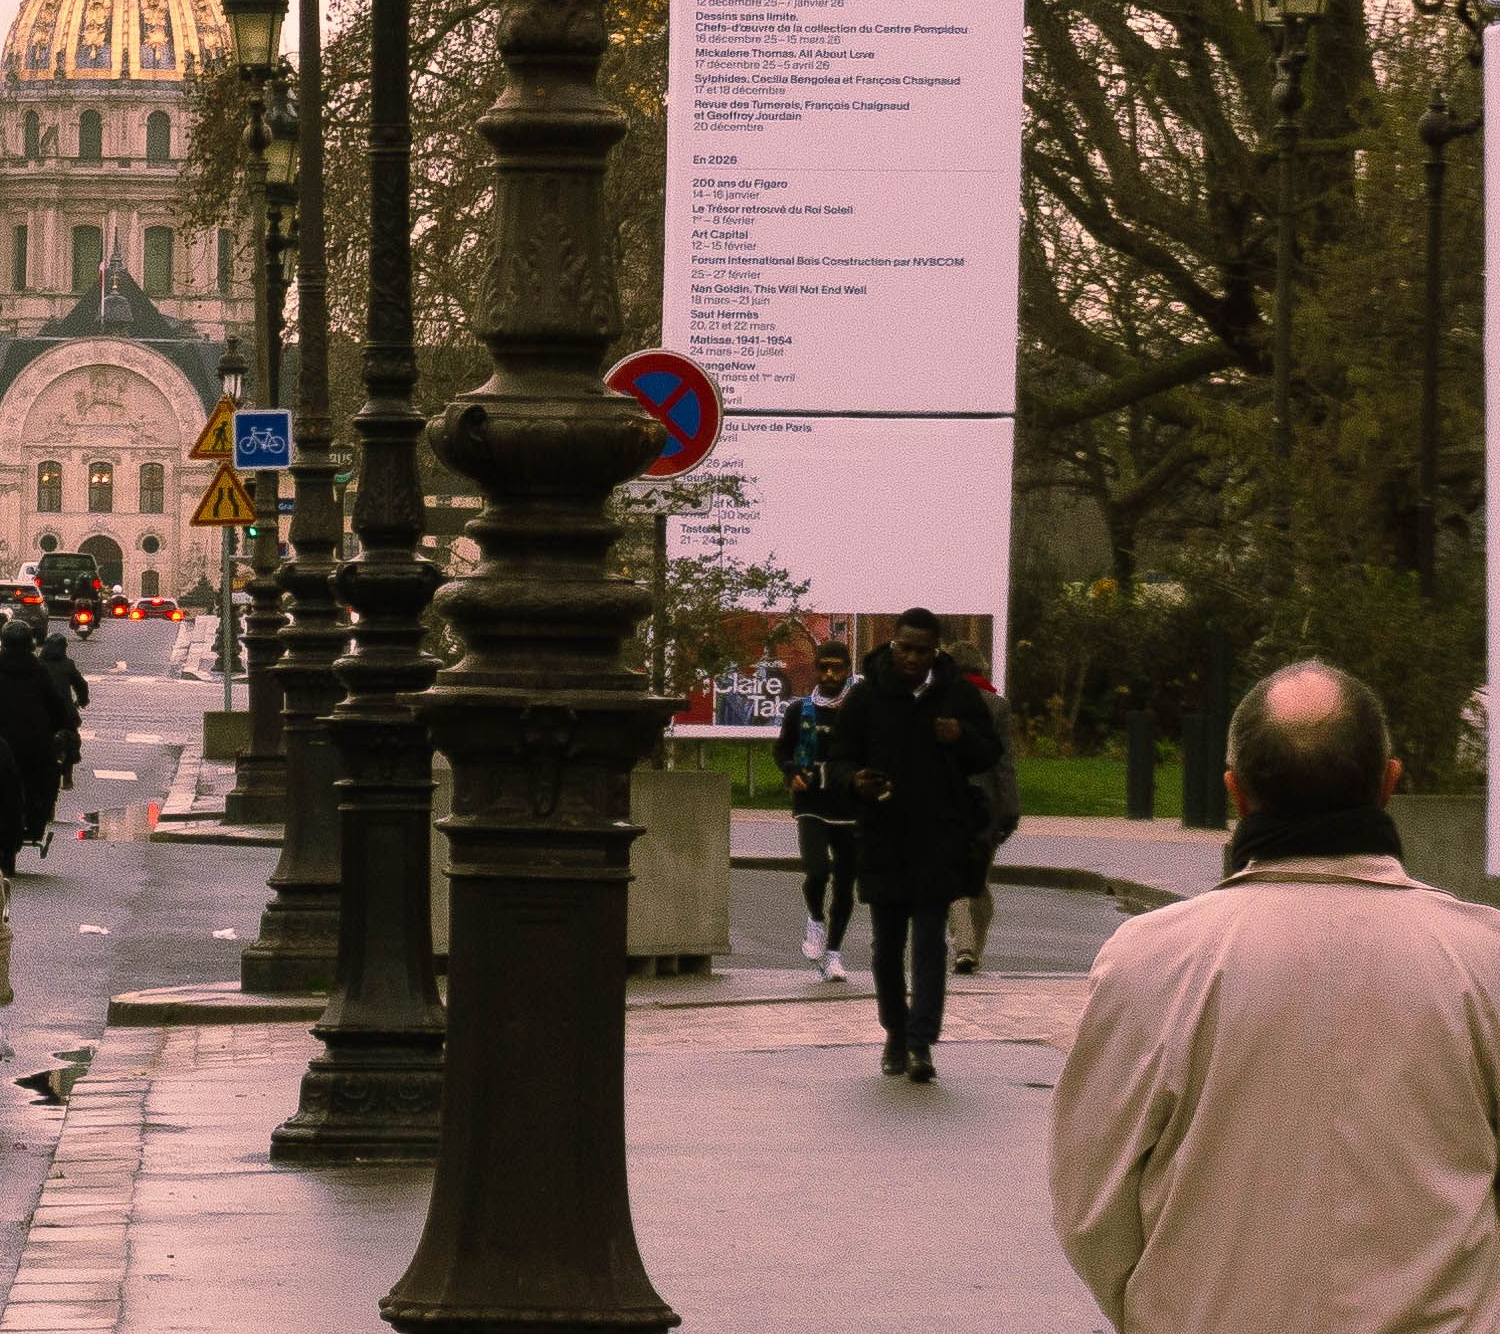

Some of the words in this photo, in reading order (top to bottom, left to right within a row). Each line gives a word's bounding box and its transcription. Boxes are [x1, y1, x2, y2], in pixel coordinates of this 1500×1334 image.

[695, 11, 738, 21] Dessins
[740, 14, 765, 22] sans
[766, 12, 798, 22] limite.
[777, 23, 791, 33] de
[793, 23, 802, 33] la
[805, 23, 857, 33] collection
[859, 23, 873, 33] du
[875, 24, 911, 34] Centre
[914, 24, 968, 36] Pompidou
[708, 34, 761, 44] décembre
[695, 49, 750, 59] Mickalene
[798, 49, 813, 59] All
[815, 49, 847, 59] About
[849, 49, 874, 59] Love
[695, 60, 705, 70] 17
[707, 60, 761, 70] décembre
[792, 60, 814, 70] avril
[751, 74, 788, 84] Cecilia
[843, 75, 853, 85] et
[855, 75, 901, 87] François
[903, 75, 961, 87] Chaignaud
[695, 85, 704, 95] 17
[706, 85, 717, 95] et
[719, 85, 730, 95] 18
[732, 86, 785, 95] décembre
[694, 100, 727, 110] Revue
[730, 100, 750, 110] des
[805, 100, 850, 112] François
[852, 100, 910, 113] Chaignaud
[694, 111, 705, 121] et
[707, 111, 754, 123] Geoffroy
[755, 111, 802, 121] Jourdain
[693, 122, 708, 132] 20
[710, 122, 764, 132] décembre
[693, 155, 706, 164] En
[708, 155, 737, 165] 2026
[693, 179, 715, 189] 200
[717, 181, 736, 189] ans
[738, 179, 752, 189] du
[754, 179, 788, 191] Figaro
[726, 190, 760, 202] janvier
[692, 204, 705, 214] Le
[707, 204, 739, 214] Trésor
[742, 204, 786, 214] retrouvé
[788, 204, 802, 214] du
[804, 204, 821, 214] Roi
[823, 204, 853, 214] Soleil
[722, 215, 755, 225] février
[691, 229, 708, 239] Art
[710, 229, 748, 241] Capital
[723, 241, 757, 251] février
[691, 255, 726, 265] Forum
[728, 255, 795, 265] International
[796, 256, 820, 266] Bois
[822, 256, 892, 266] Construction
[894, 258, 911, 268] par
[728, 269, 761, 279] février
[691, 284, 712, 294] Nan
[754, 284, 776, 294] This
[778, 284, 798, 294] Will
[800, 284, 819, 294] Not
[821, 284, 841, 294] End
[843, 284, 867, 294] Well
[691, 295, 701, 305] 18
[703, 297, 730, 305] mars
[690, 309, 715, 319] Saut
[717, 309, 758, 319] Hermès
[708, 321, 720, 331] 21
[721, 321, 732, 331] et
[733, 321, 748, 331] 22
[749, 323, 775, 331] mars
[689, 346, 704, 356] 24
[706, 348, 732, 356] mars
[756, 346, 784, 358] juillet
[721, 374, 747, 382] mars
[749, 372, 760, 382] et
[773, 372, 795, 382] avril
[725, 422, 739, 432] du
[741, 422, 767, 432] Livre
[770, 422, 784, 432] de
[785, 422, 812, 432] Paris
[724, 523, 750, 533] Paris
